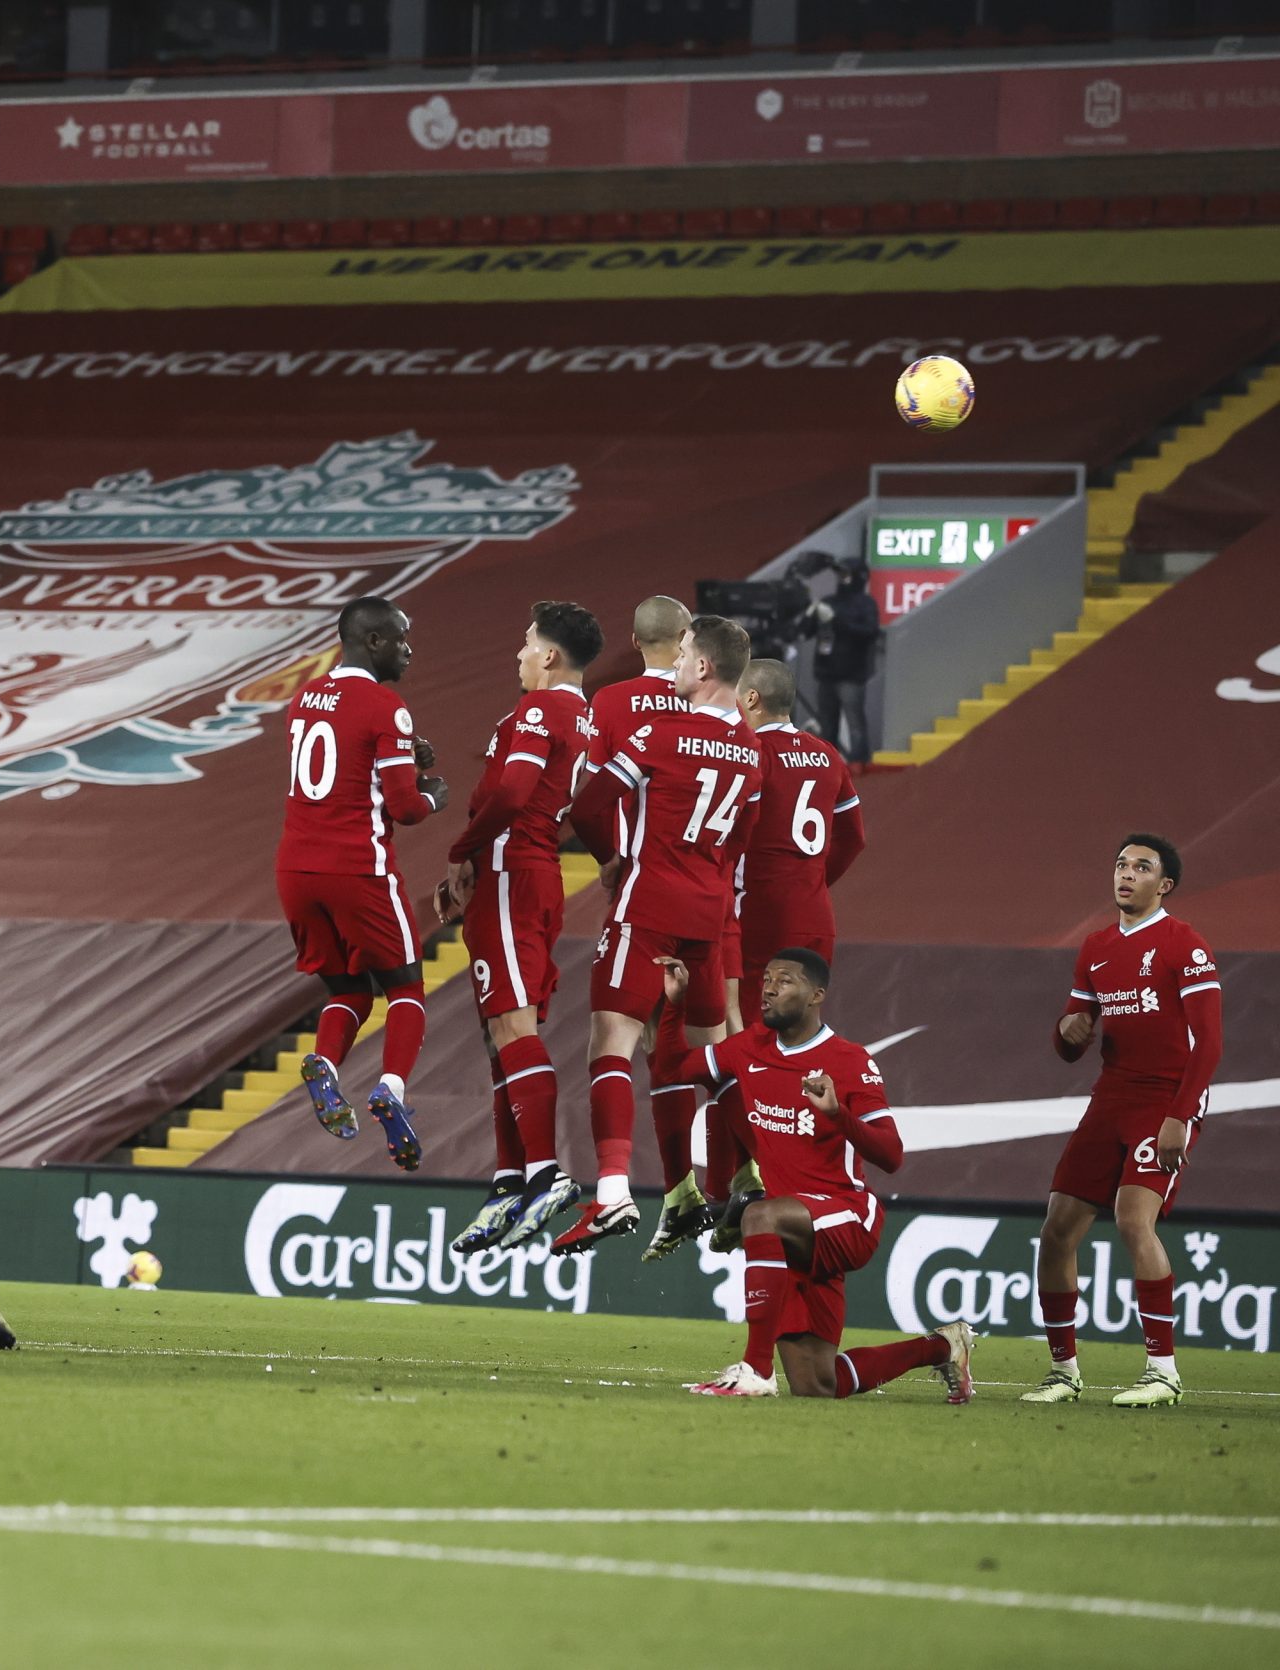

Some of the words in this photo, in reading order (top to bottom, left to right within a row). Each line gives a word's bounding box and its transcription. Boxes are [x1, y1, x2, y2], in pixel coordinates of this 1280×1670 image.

[89, 120, 220, 142] STELLAR
[457, 123, 550, 150] certas
[92, 142, 213, 158] FOOTBALL
[327, 253, 442, 277] WE
[427, 249, 588, 274] ARE
[589, 245, 752, 271] ONE
[754, 239, 961, 270] TEAM
[877, 529, 936, 557] EXIT
[300, 691, 341, 712] MANÉ
[630, 695, 693, 713] FABIN
[288, 718, 337, 800] 10
[677, 736, 759, 768] HENDERSON
[778, 751, 830, 768] THIAGO
[683, 767, 746, 846] 14
[791, 779, 826, 856] 6
[474, 958, 491, 993] 9
[1096, 988, 1137, 1004] Standard
[754, 1099, 795, 1120] Standard
[1133, 1136, 1156, 1164] 6
[244, 1183, 597, 1315] Carlsberg
[885, 1214, 1278, 1354] Carbrg
